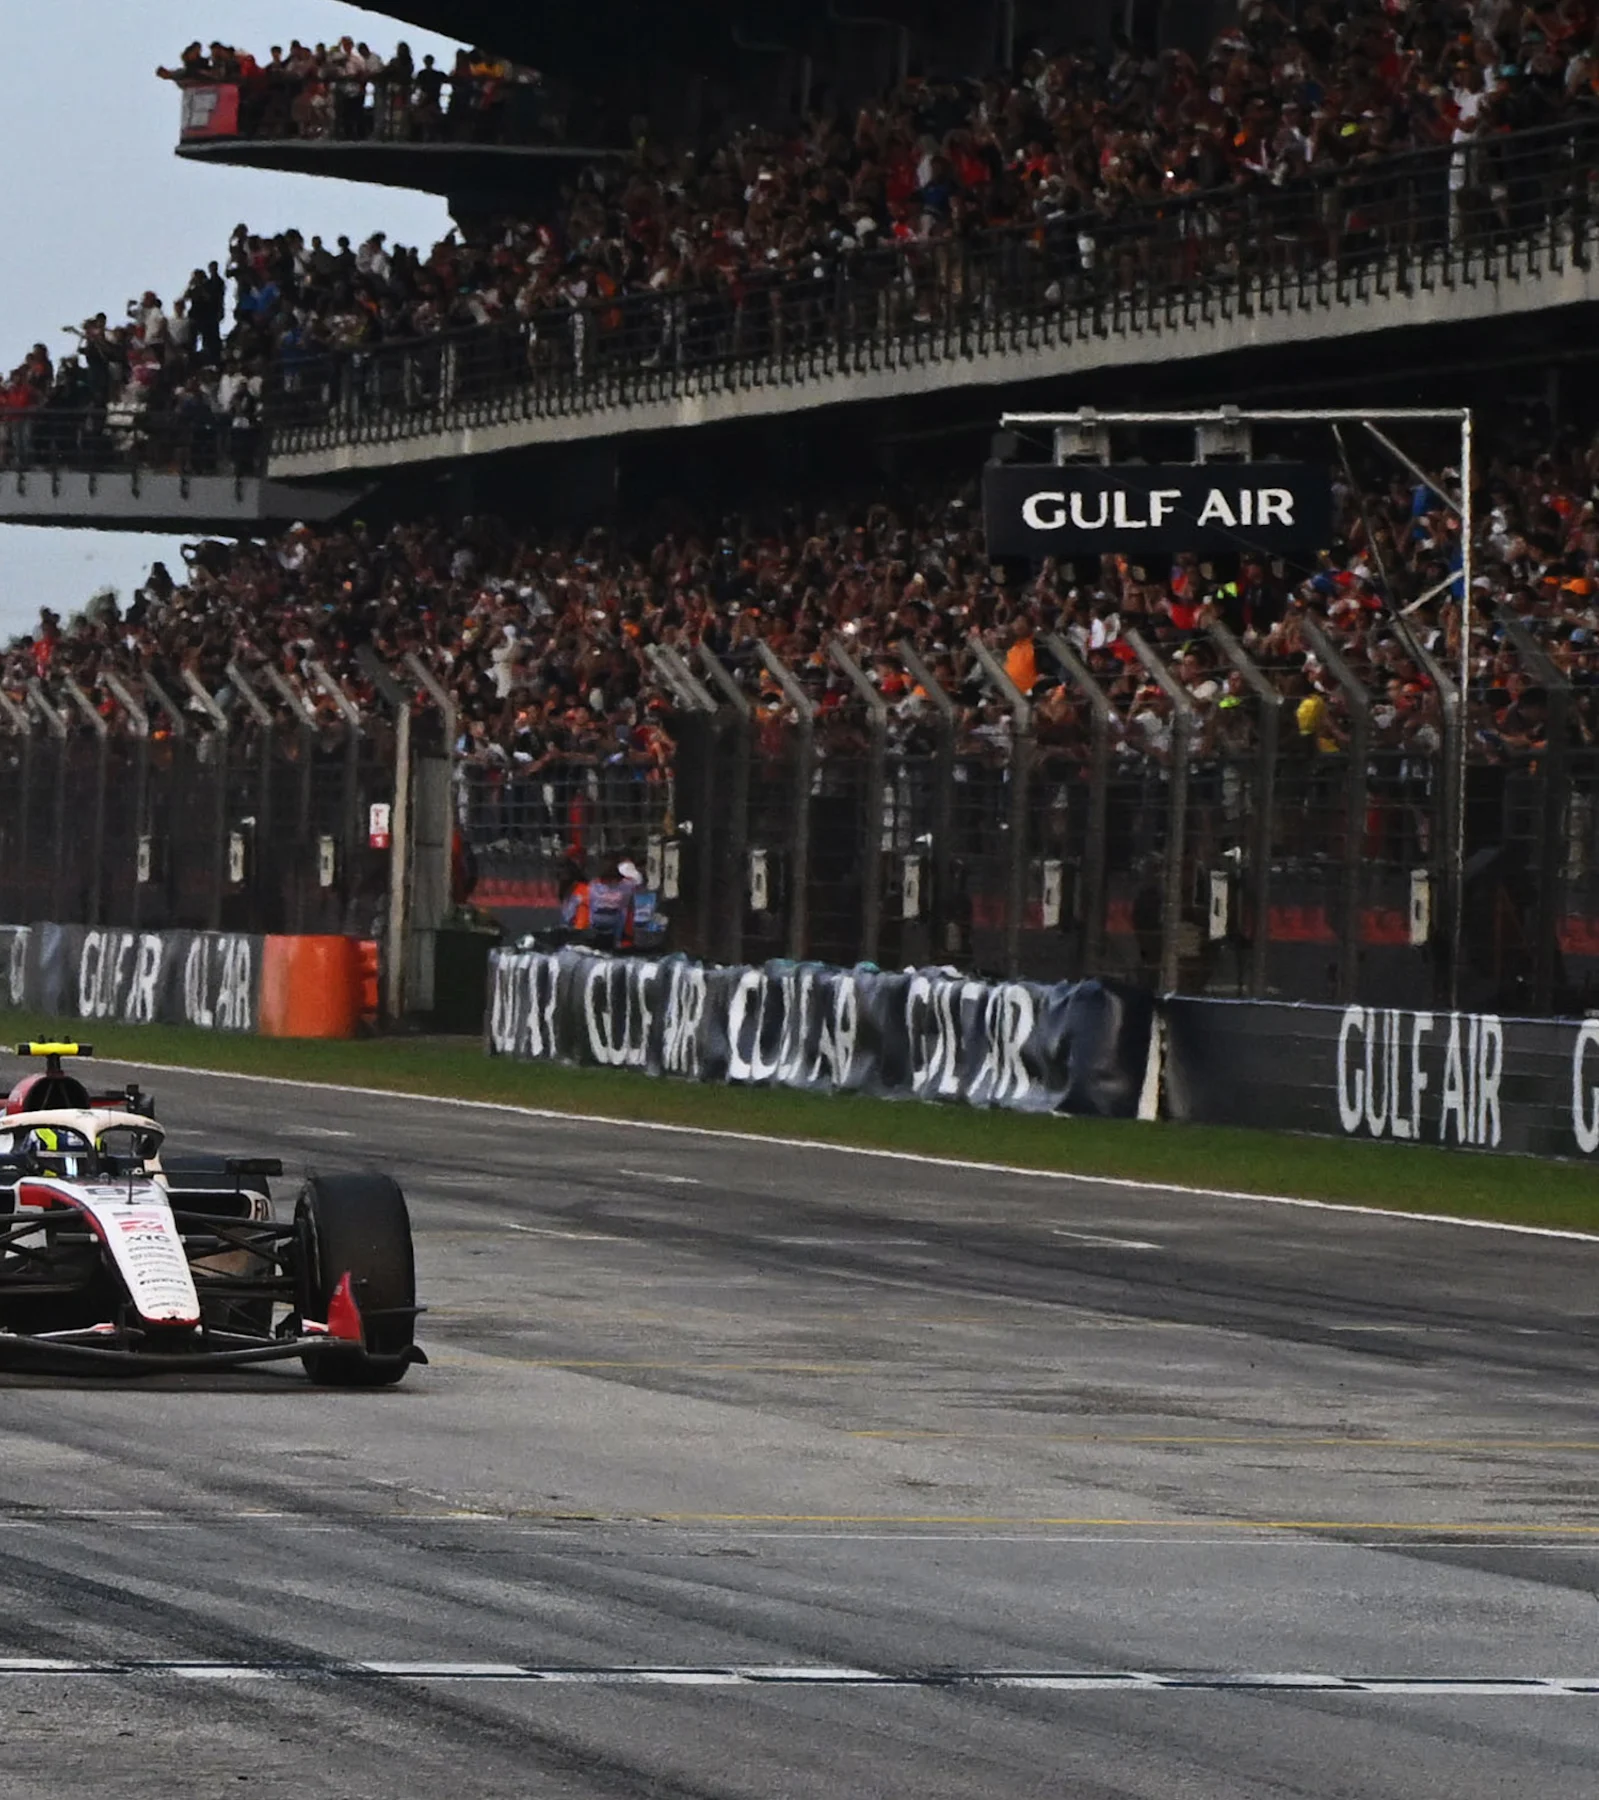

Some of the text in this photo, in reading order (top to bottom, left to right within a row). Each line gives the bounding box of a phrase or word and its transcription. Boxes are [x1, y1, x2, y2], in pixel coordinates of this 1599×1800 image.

[1021, 487, 1295, 531] GULF AIR
[1337, 1004, 1501, 1148] GULF AIR
